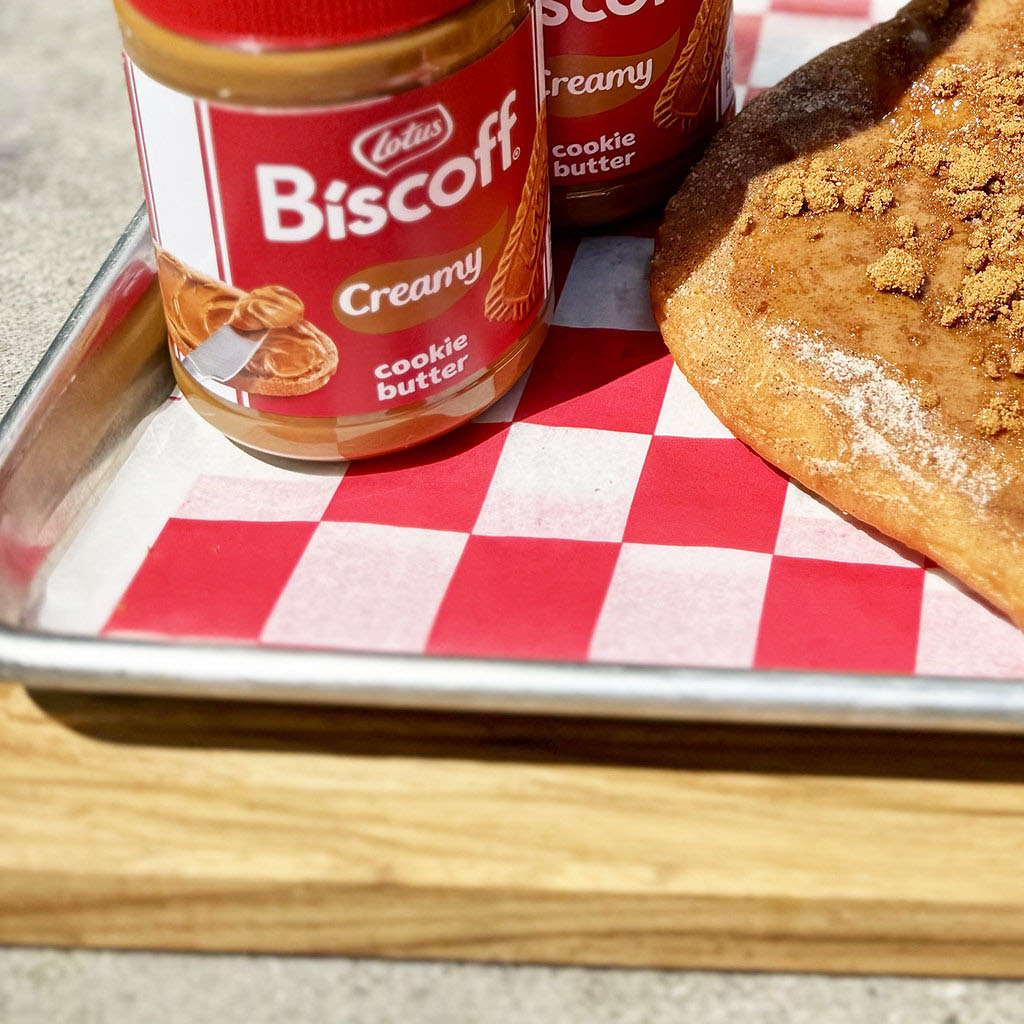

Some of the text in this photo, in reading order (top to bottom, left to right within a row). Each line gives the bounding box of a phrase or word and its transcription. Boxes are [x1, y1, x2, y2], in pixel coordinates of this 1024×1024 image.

[371, 118, 443, 164] Lotus
[551, 131, 636, 157] cookie
[553, 151, 636, 177] butter
[255, 89, 518, 243] Biscoff
[338, 247, 483, 316] Creamy
[374, 334, 468, 379] cookie
[376, 354, 469, 401] butter
